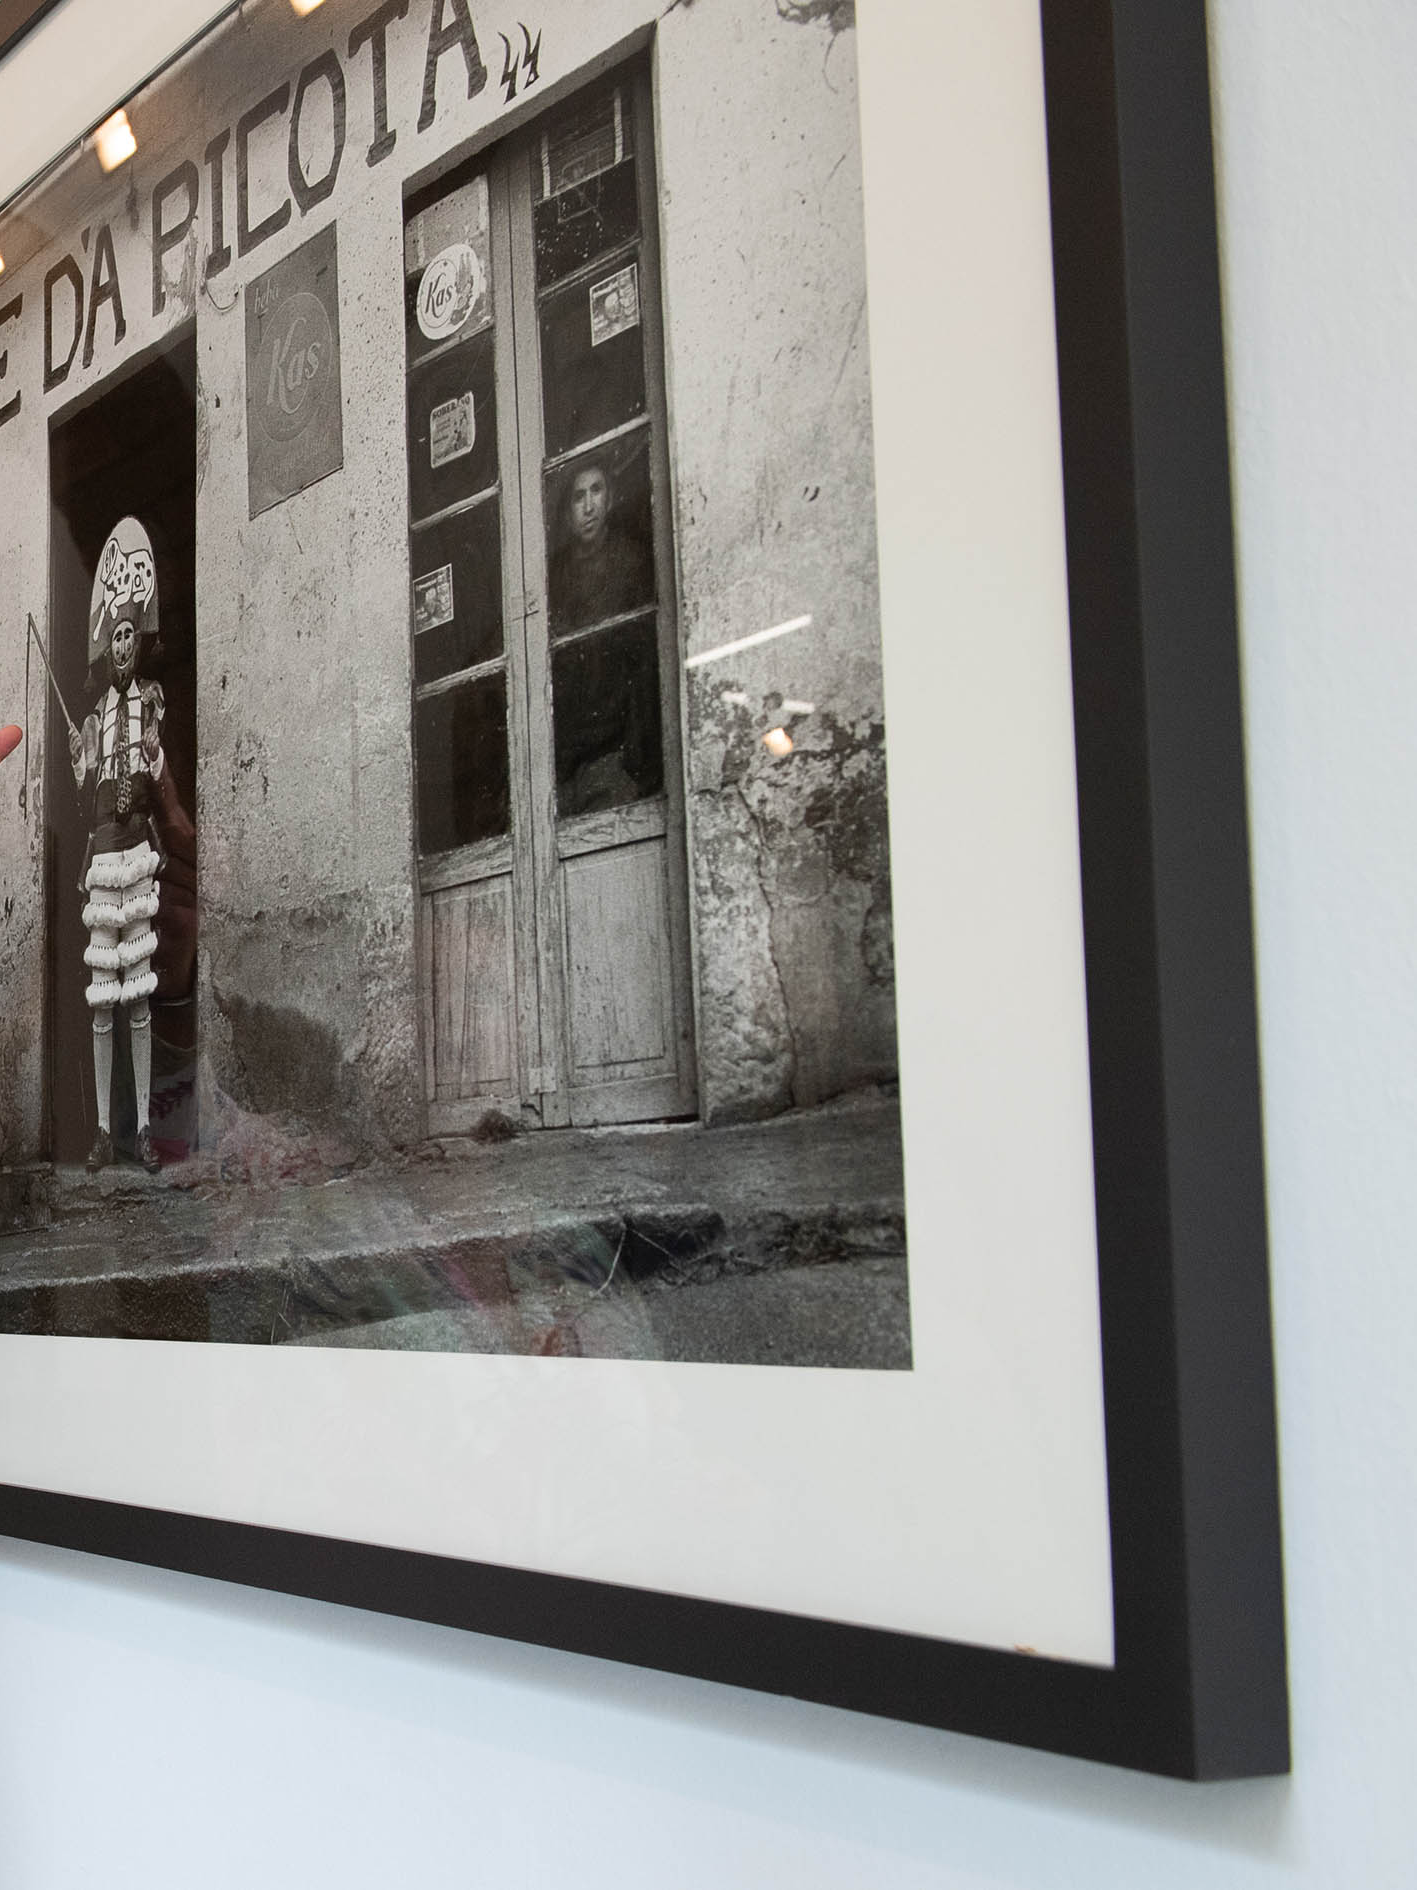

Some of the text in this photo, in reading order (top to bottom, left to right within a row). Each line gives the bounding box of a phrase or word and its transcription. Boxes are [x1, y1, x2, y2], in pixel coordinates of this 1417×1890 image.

[152, 0, 488, 318] PICOTA
[424, 272, 454, 319] Kas
[266, 317, 322, 414] Kas
[432, 395, 471, 421] SOBERNO
